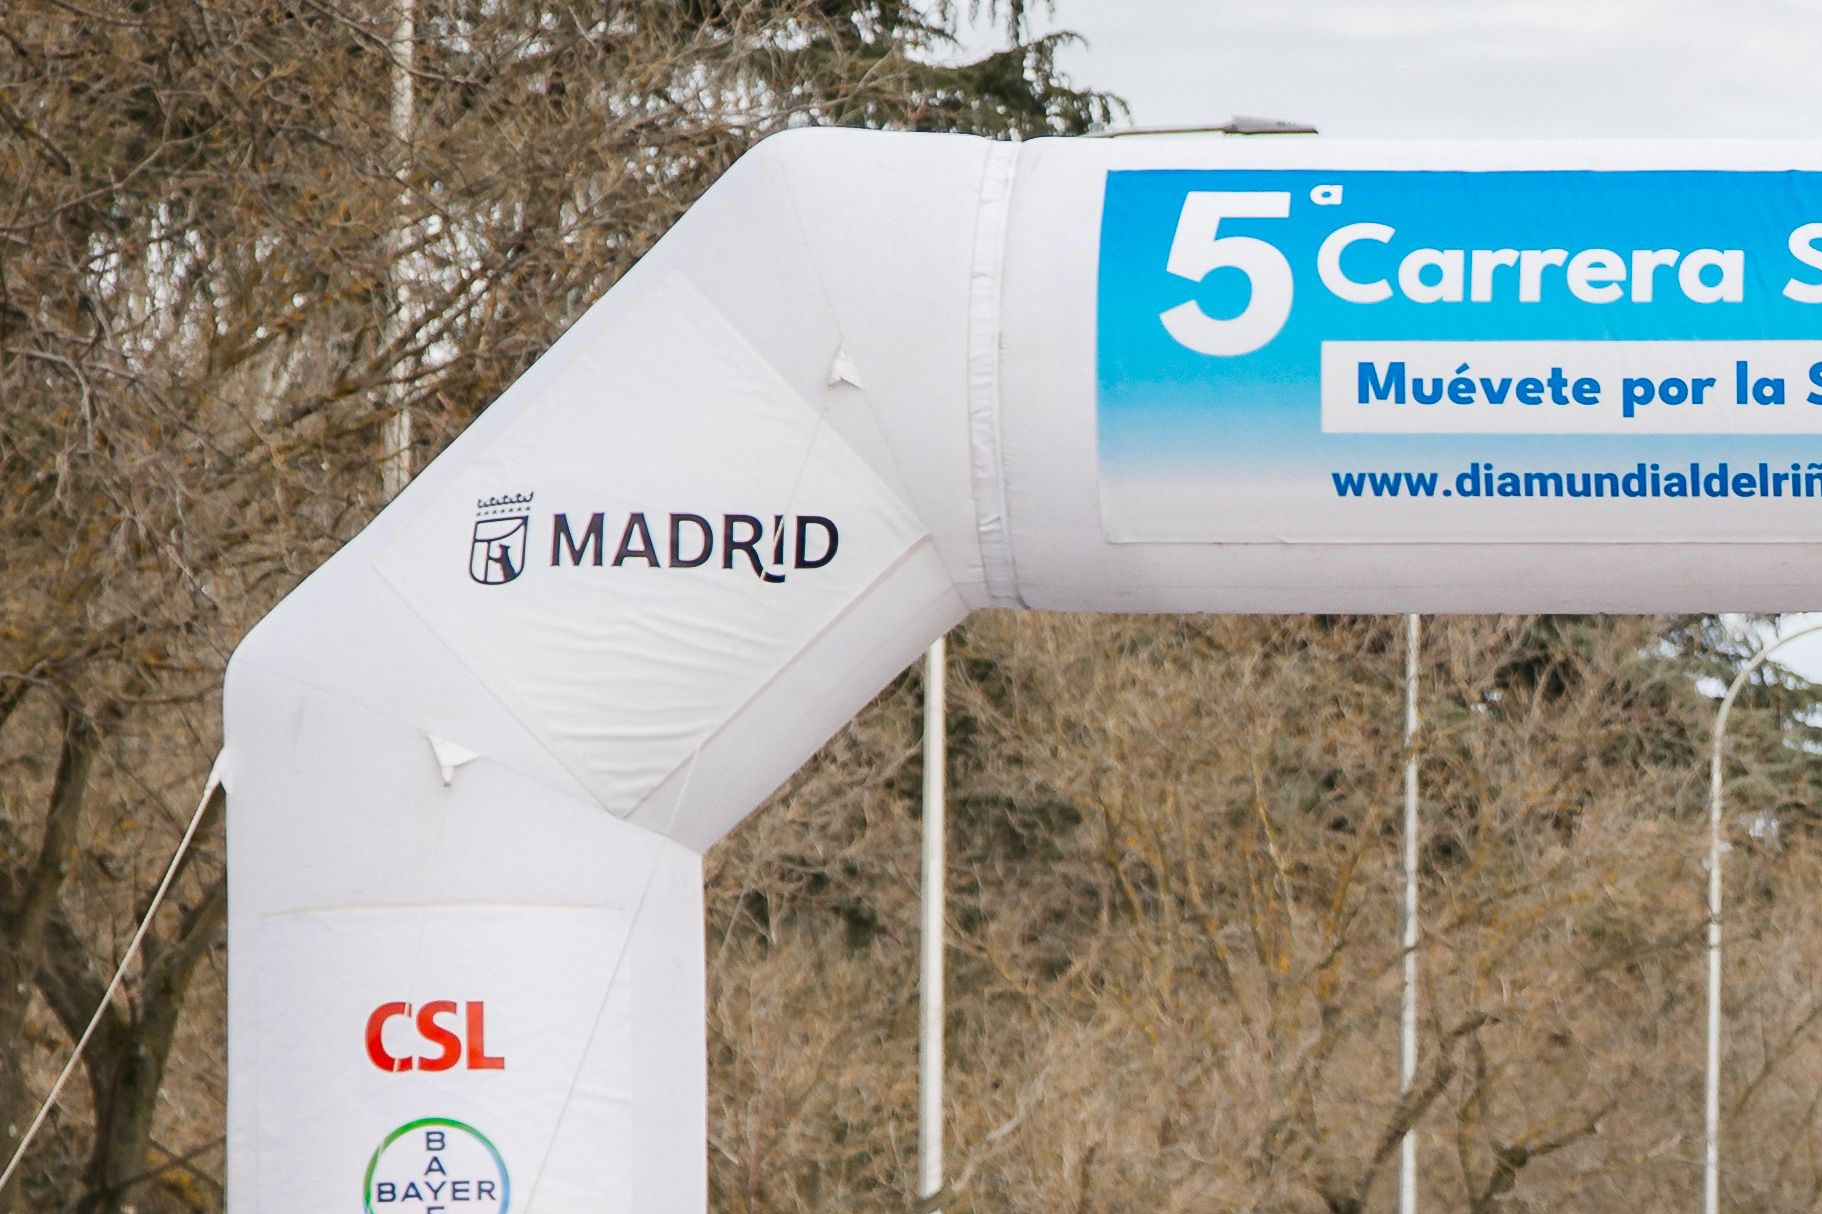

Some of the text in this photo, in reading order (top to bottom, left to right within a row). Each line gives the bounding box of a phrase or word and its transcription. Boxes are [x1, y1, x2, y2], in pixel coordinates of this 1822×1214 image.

[1316, 222, 1744, 304] Carrera
[1357, 362, 1601, 406] Muévete
[1622, 375, 1716, 418] por
[1736, 361, 1785, 406] la
[549, 511, 840, 584] MADRID
[364, 1000, 505, 1072] CSL
[377, 1179, 497, 1202] BAYER
